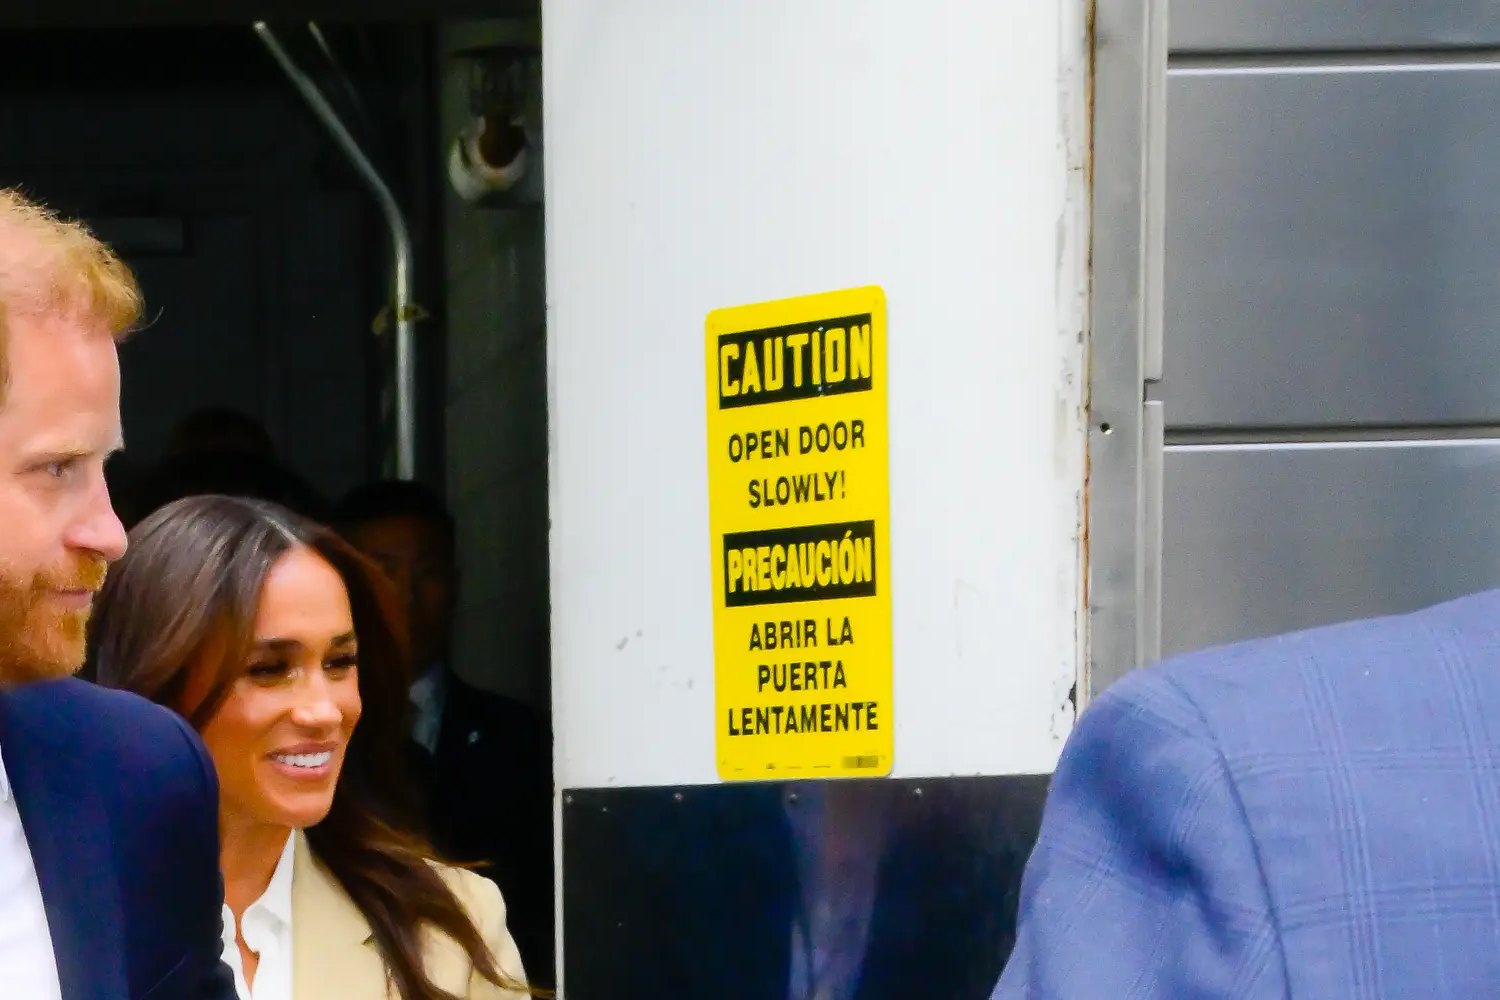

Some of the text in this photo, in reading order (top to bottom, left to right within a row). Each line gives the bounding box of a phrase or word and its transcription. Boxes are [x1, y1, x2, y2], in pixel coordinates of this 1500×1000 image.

[720, 323, 871, 397] CAUTION
[728, 420, 865, 463] OPEN DOOR
[748, 470, 846, 508] SLOWLY!
[727, 530, 873, 593] PRECAUCIÓN
[749, 616, 854, 651] ABRIR LA
[758, 660, 847, 692] PUERTA
[728, 702, 879, 736] LENTAMENTE
